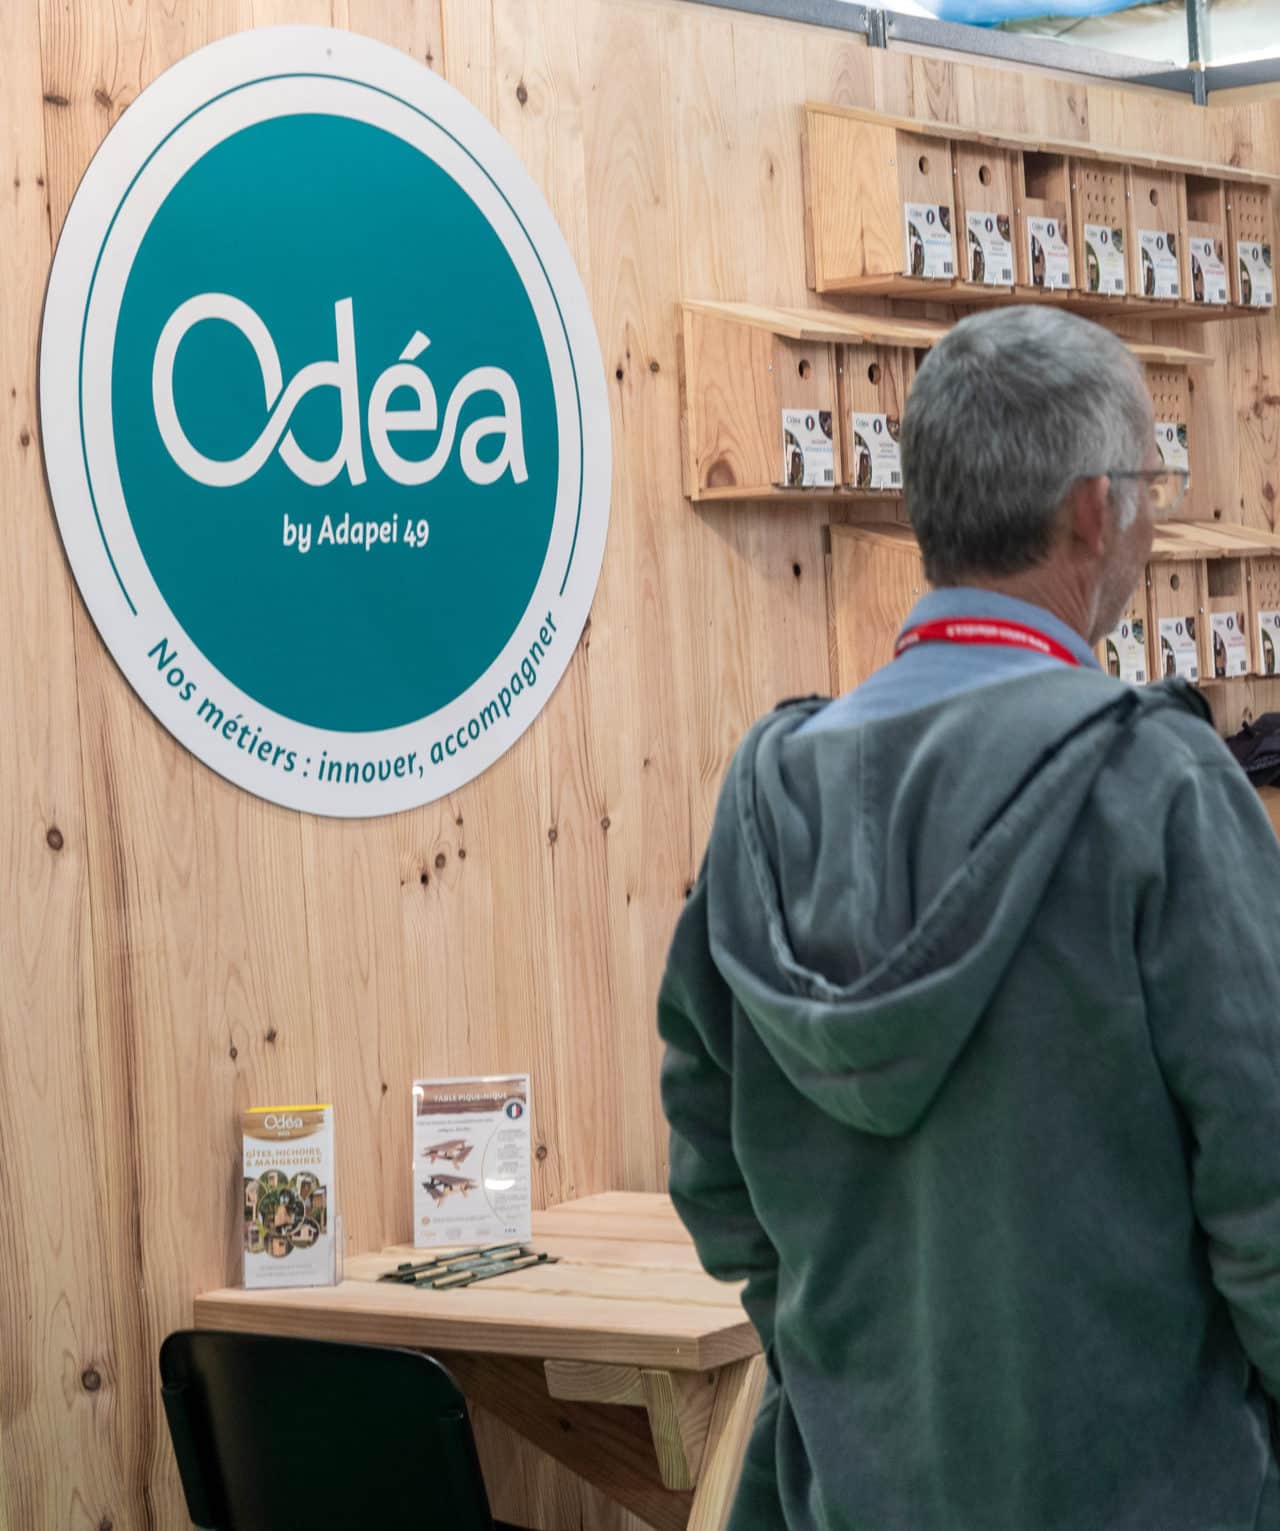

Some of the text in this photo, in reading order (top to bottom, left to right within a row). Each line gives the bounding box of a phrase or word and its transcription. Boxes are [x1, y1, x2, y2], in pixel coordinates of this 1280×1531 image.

[152, 292, 529, 487] Odéa
[283, 513, 430, 553] by Adapei 49
[147, 637, 197, 701] Nos
[197, 698, 297, 772] métiers
[318, 751, 424, 784] innover,
[430, 611, 557, 765] accompagner
[264, 1114, 304, 1129] Odéa
